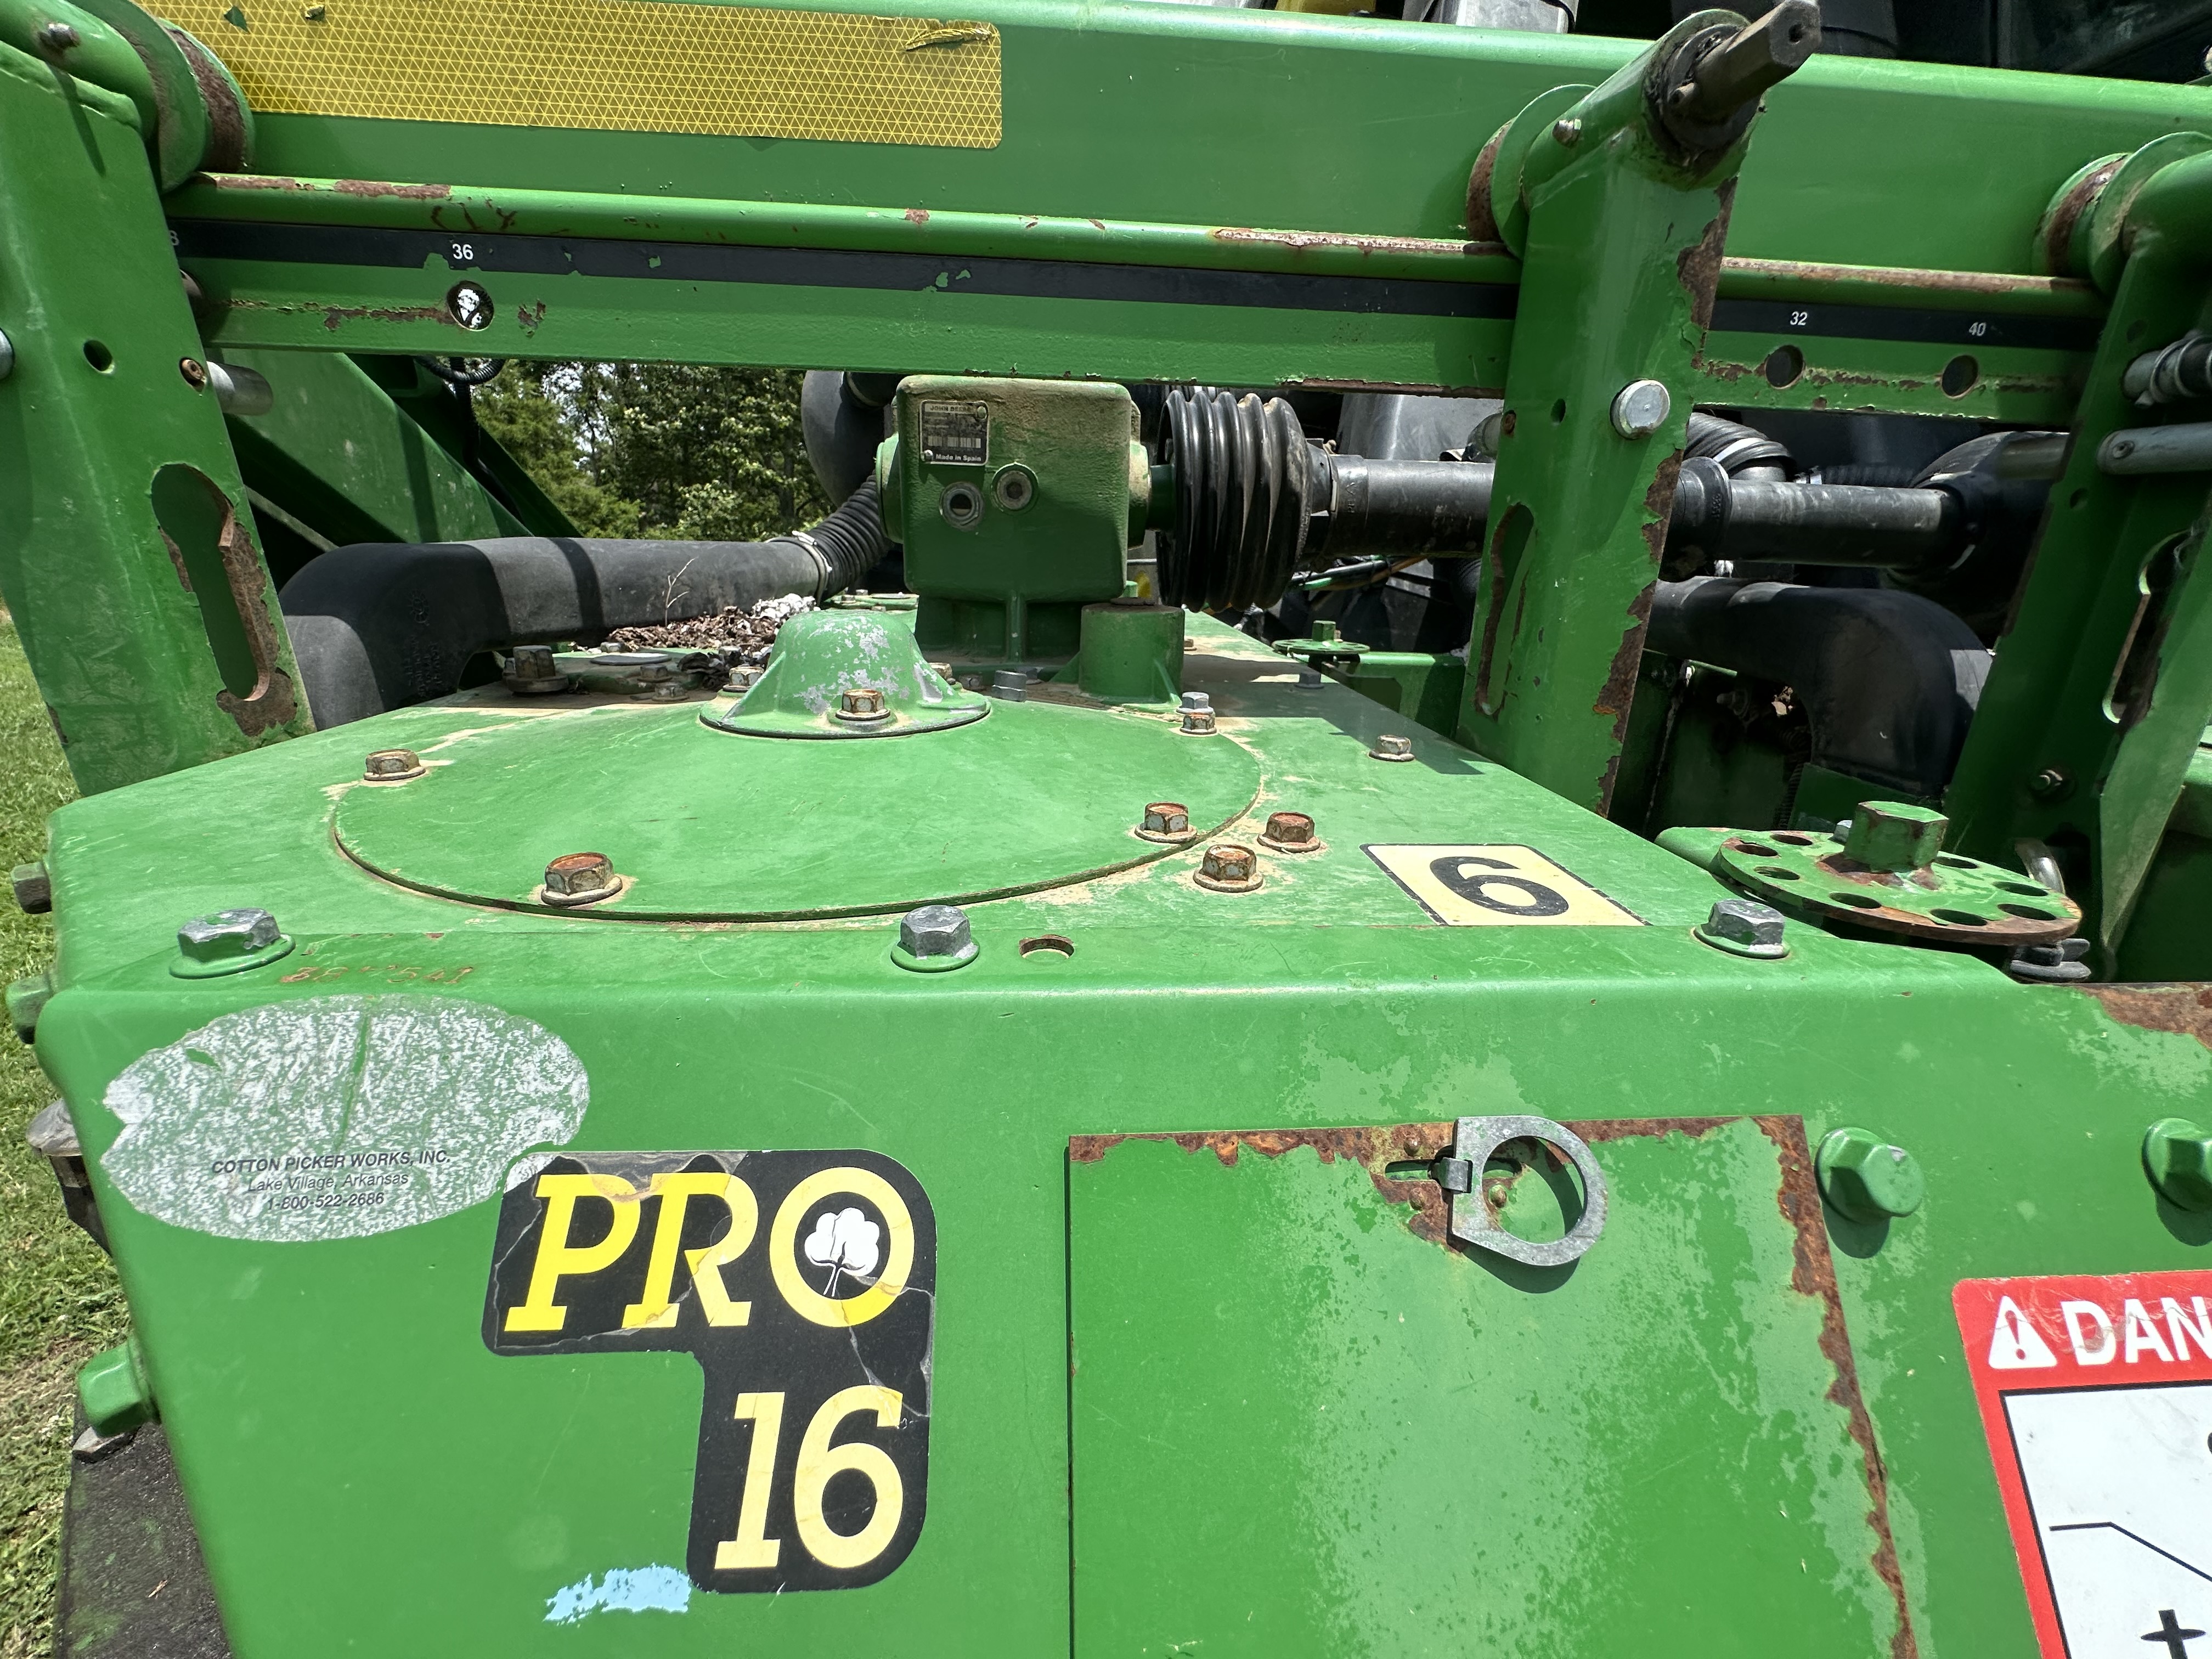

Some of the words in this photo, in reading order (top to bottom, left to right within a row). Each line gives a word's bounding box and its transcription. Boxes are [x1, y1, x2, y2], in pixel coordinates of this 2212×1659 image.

[452, 243, 474, 260] 36
[1790, 311, 1808, 326] 32
[1968, 321, 1987, 336] 40
[1429, 856, 1569, 916] 6
[212, 1158, 281, 1173] COTTON
[284, 1155, 345, 1171] PICKER
[350, 1152, 415, 1167] WORKS,
[419, 1150, 450, 1164] INC.
[248, 1178, 283, 1192] Lake
[288, 1176, 337, 1192] Village,
[341, 1173, 409, 1188] Arkansas
[267, 1192, 385, 1210] 1-800-522-2686
[504, 1166, 915, 1331] PRO
[2061, 1296, 2212, 1365] DAN
[714, 1384, 904, 1570] 16
